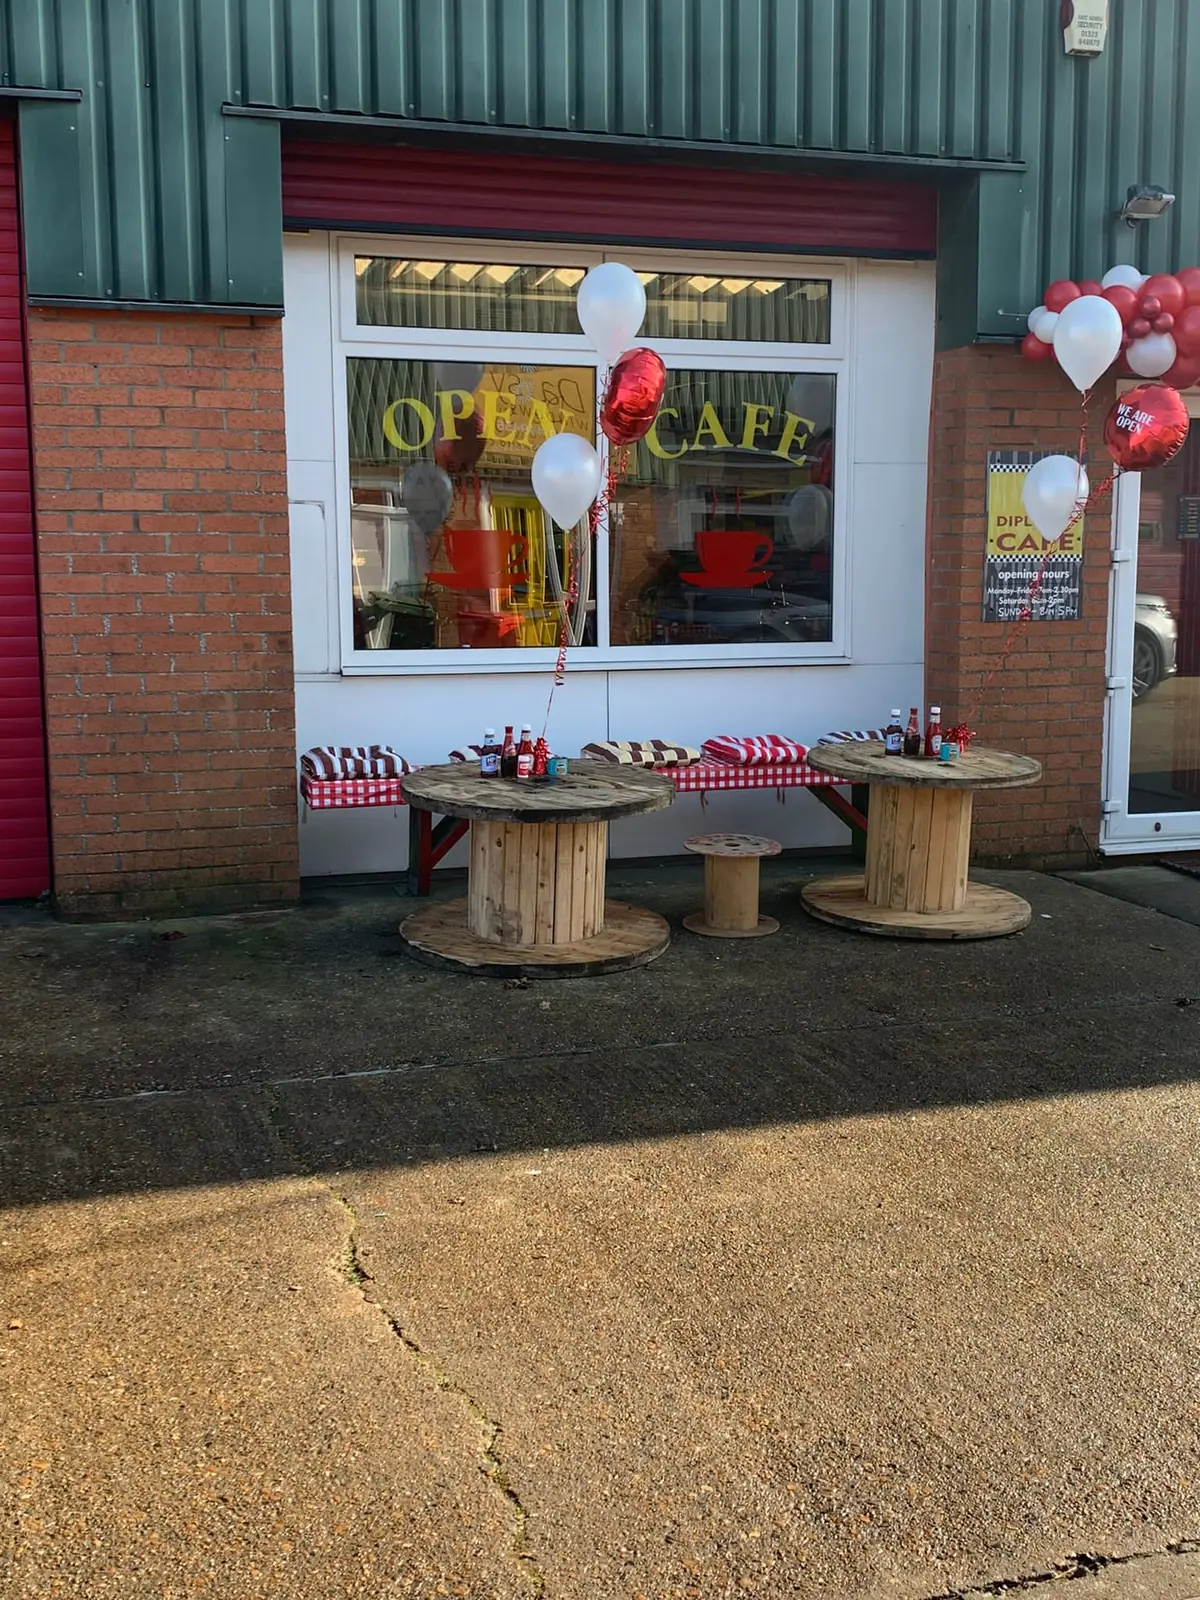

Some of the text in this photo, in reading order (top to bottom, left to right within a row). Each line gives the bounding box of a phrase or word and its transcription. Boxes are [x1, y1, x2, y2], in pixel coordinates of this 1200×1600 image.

[1077, 21, 1103, 29] SECURITY
[1117, 403, 1155, 426] WE ARE
[383, 389, 816, 467] OPEN CAFE
[1116, 415, 1142, 434] OPEN
[998, 568, 1038, 581] opening
[987, 587, 1036, 596] Monday-Frid
[998, 607, 1031, 617] SUND
